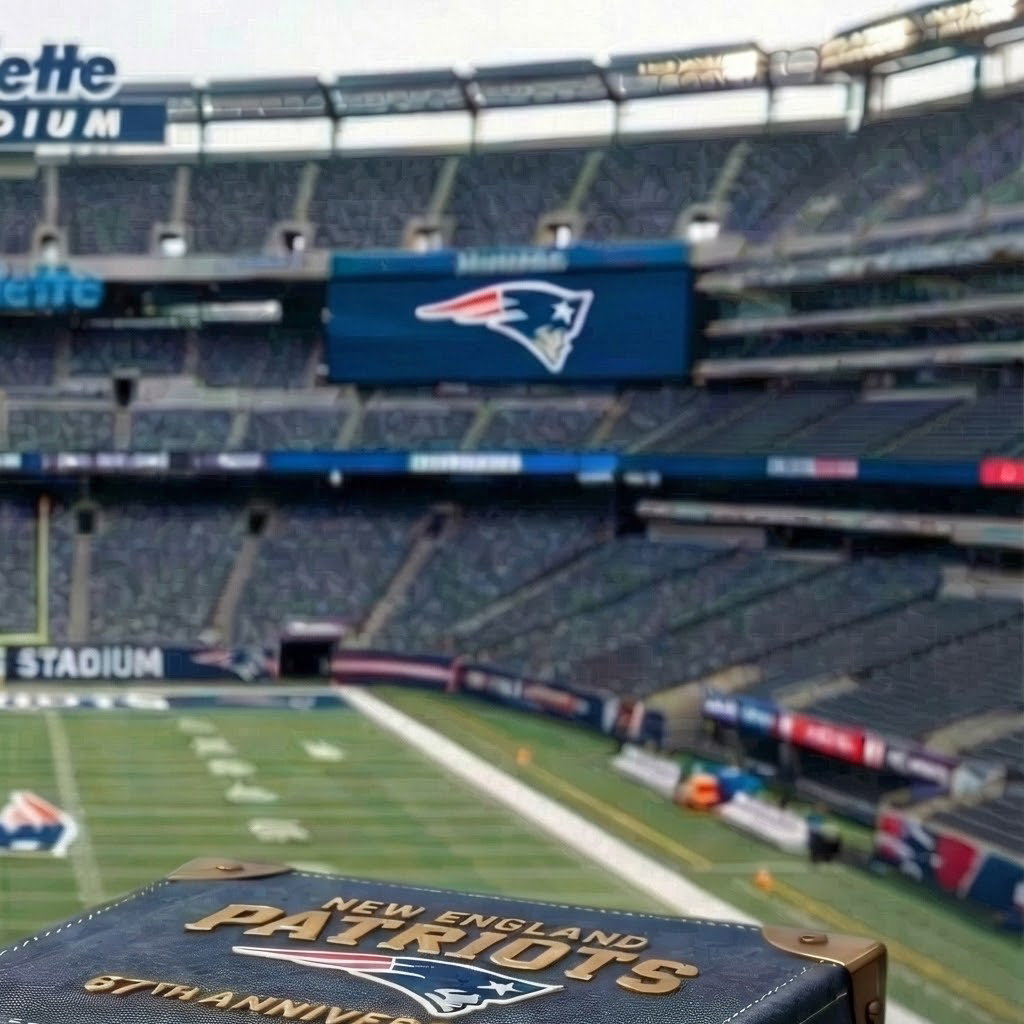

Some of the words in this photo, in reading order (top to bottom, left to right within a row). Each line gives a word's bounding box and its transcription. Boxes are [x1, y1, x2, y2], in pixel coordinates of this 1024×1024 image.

[15, 646, 164, 679] STADIUM
[184, 903, 699, 995] PATRIOTS
[323, 896, 426, 920] NEW
[442, 910, 648, 950] ENGLAND
